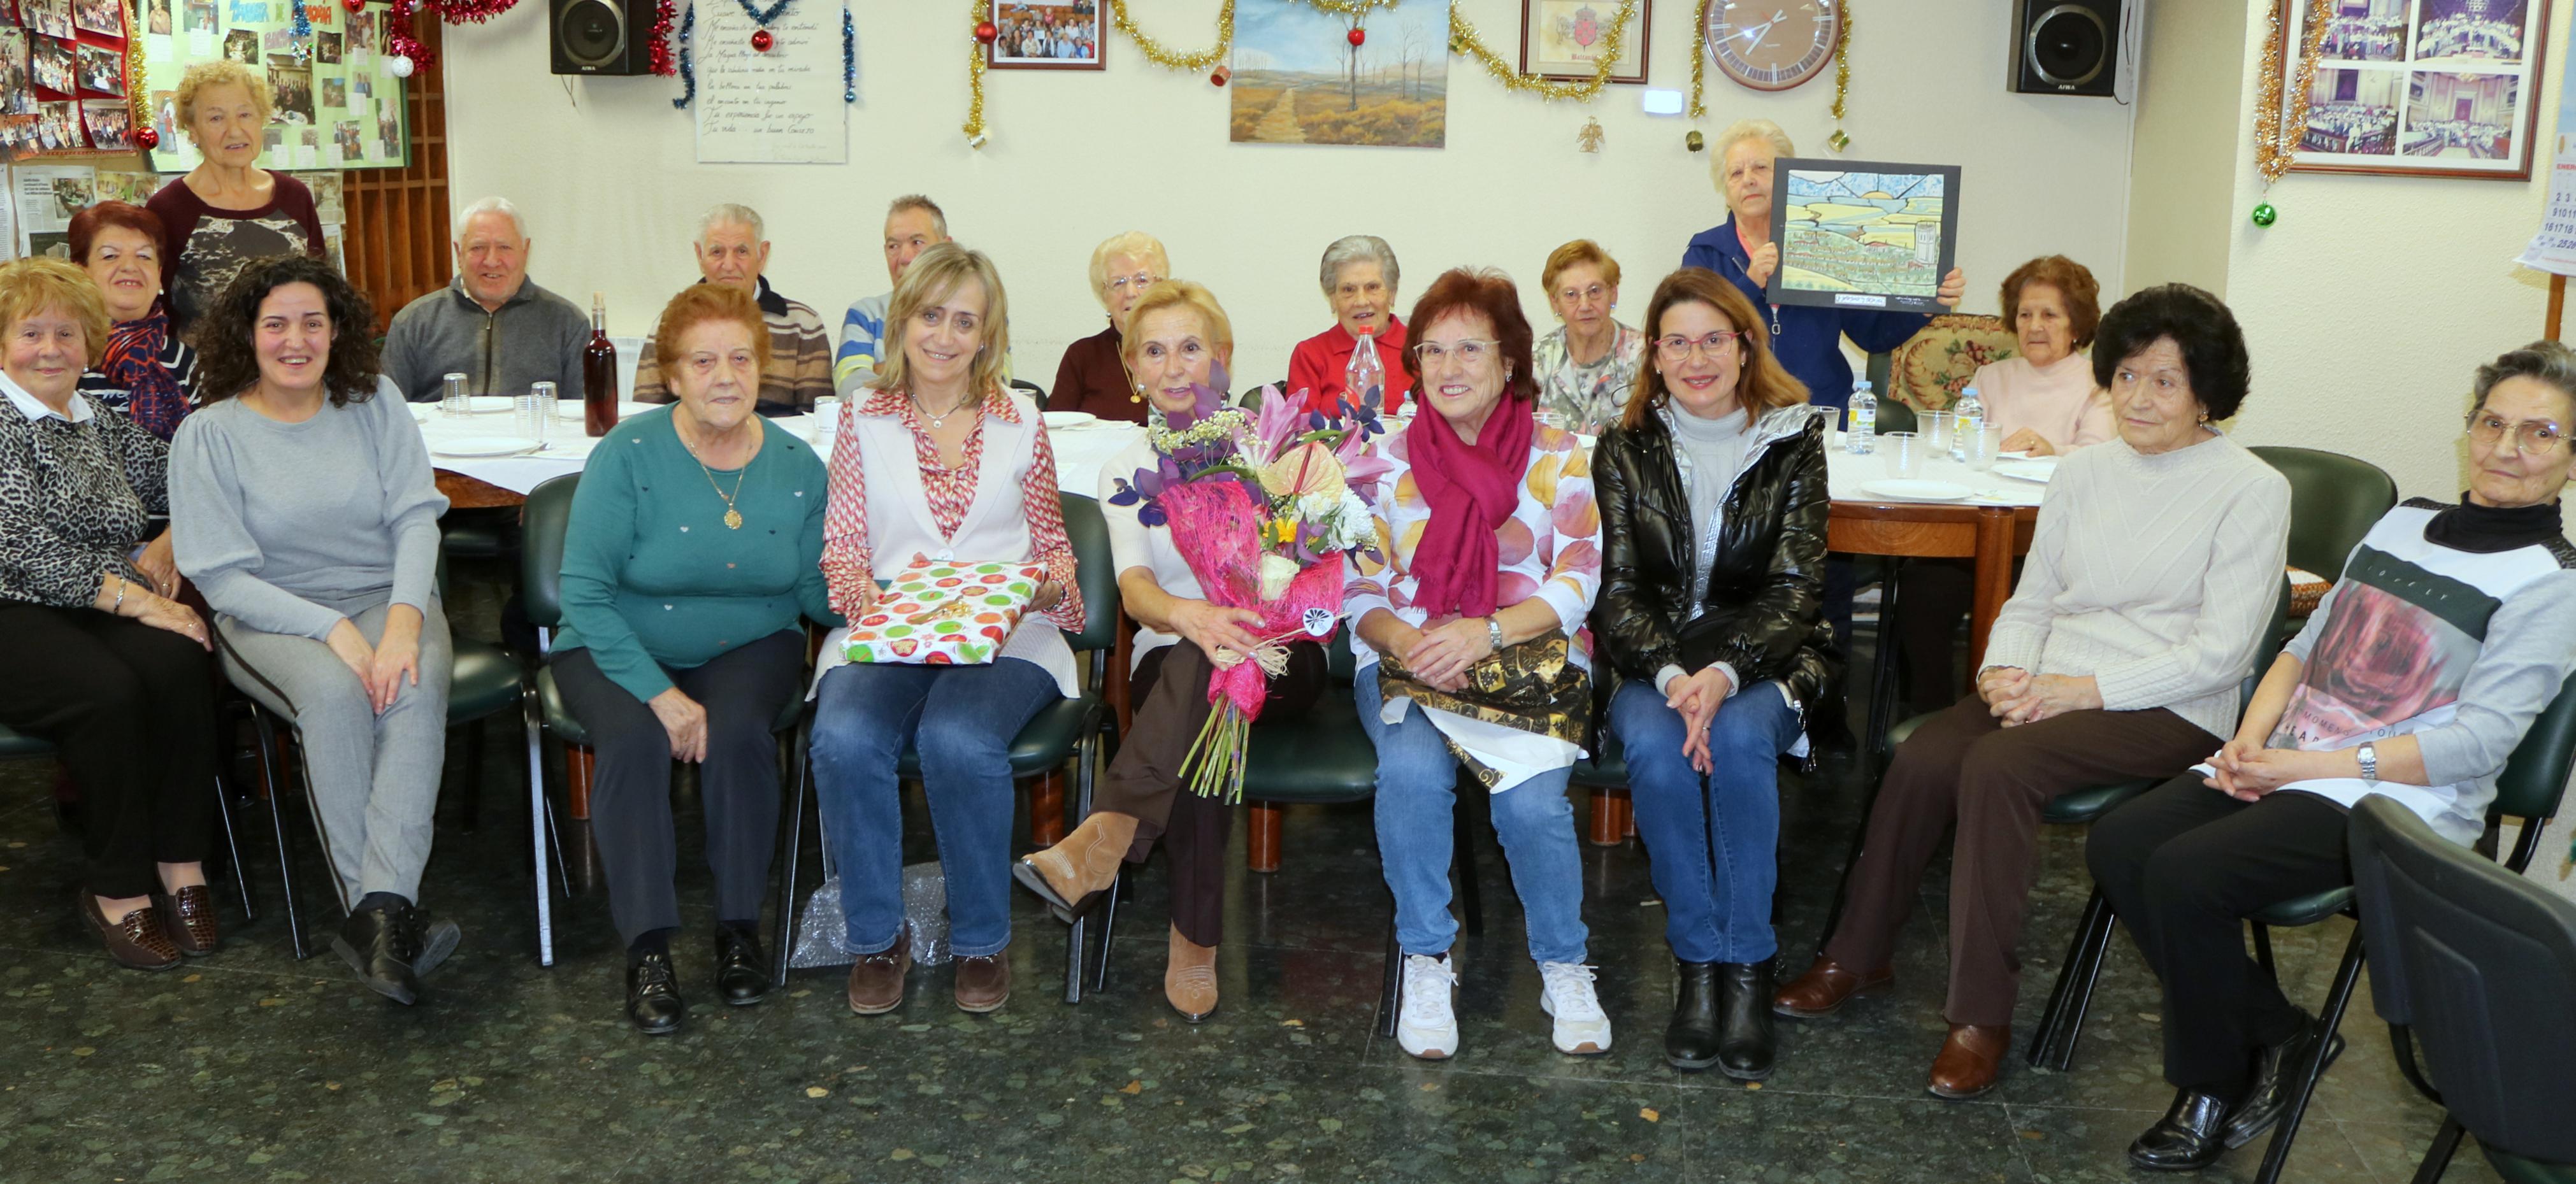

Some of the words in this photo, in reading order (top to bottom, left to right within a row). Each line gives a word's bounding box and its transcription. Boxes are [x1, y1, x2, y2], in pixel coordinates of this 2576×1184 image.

[2556, 192, 2561, 201] 2
[2565, 193, 2570, 203] 3
[2552, 207, 2558, 217] 9
[2558, 208, 2566, 217] 10
[2544, 222, 2554, 231] 16
[2554, 223, 2564, 232] 17
[2564, 224, 2573, 234] 18
[2556, 239, 2568, 248] 25
